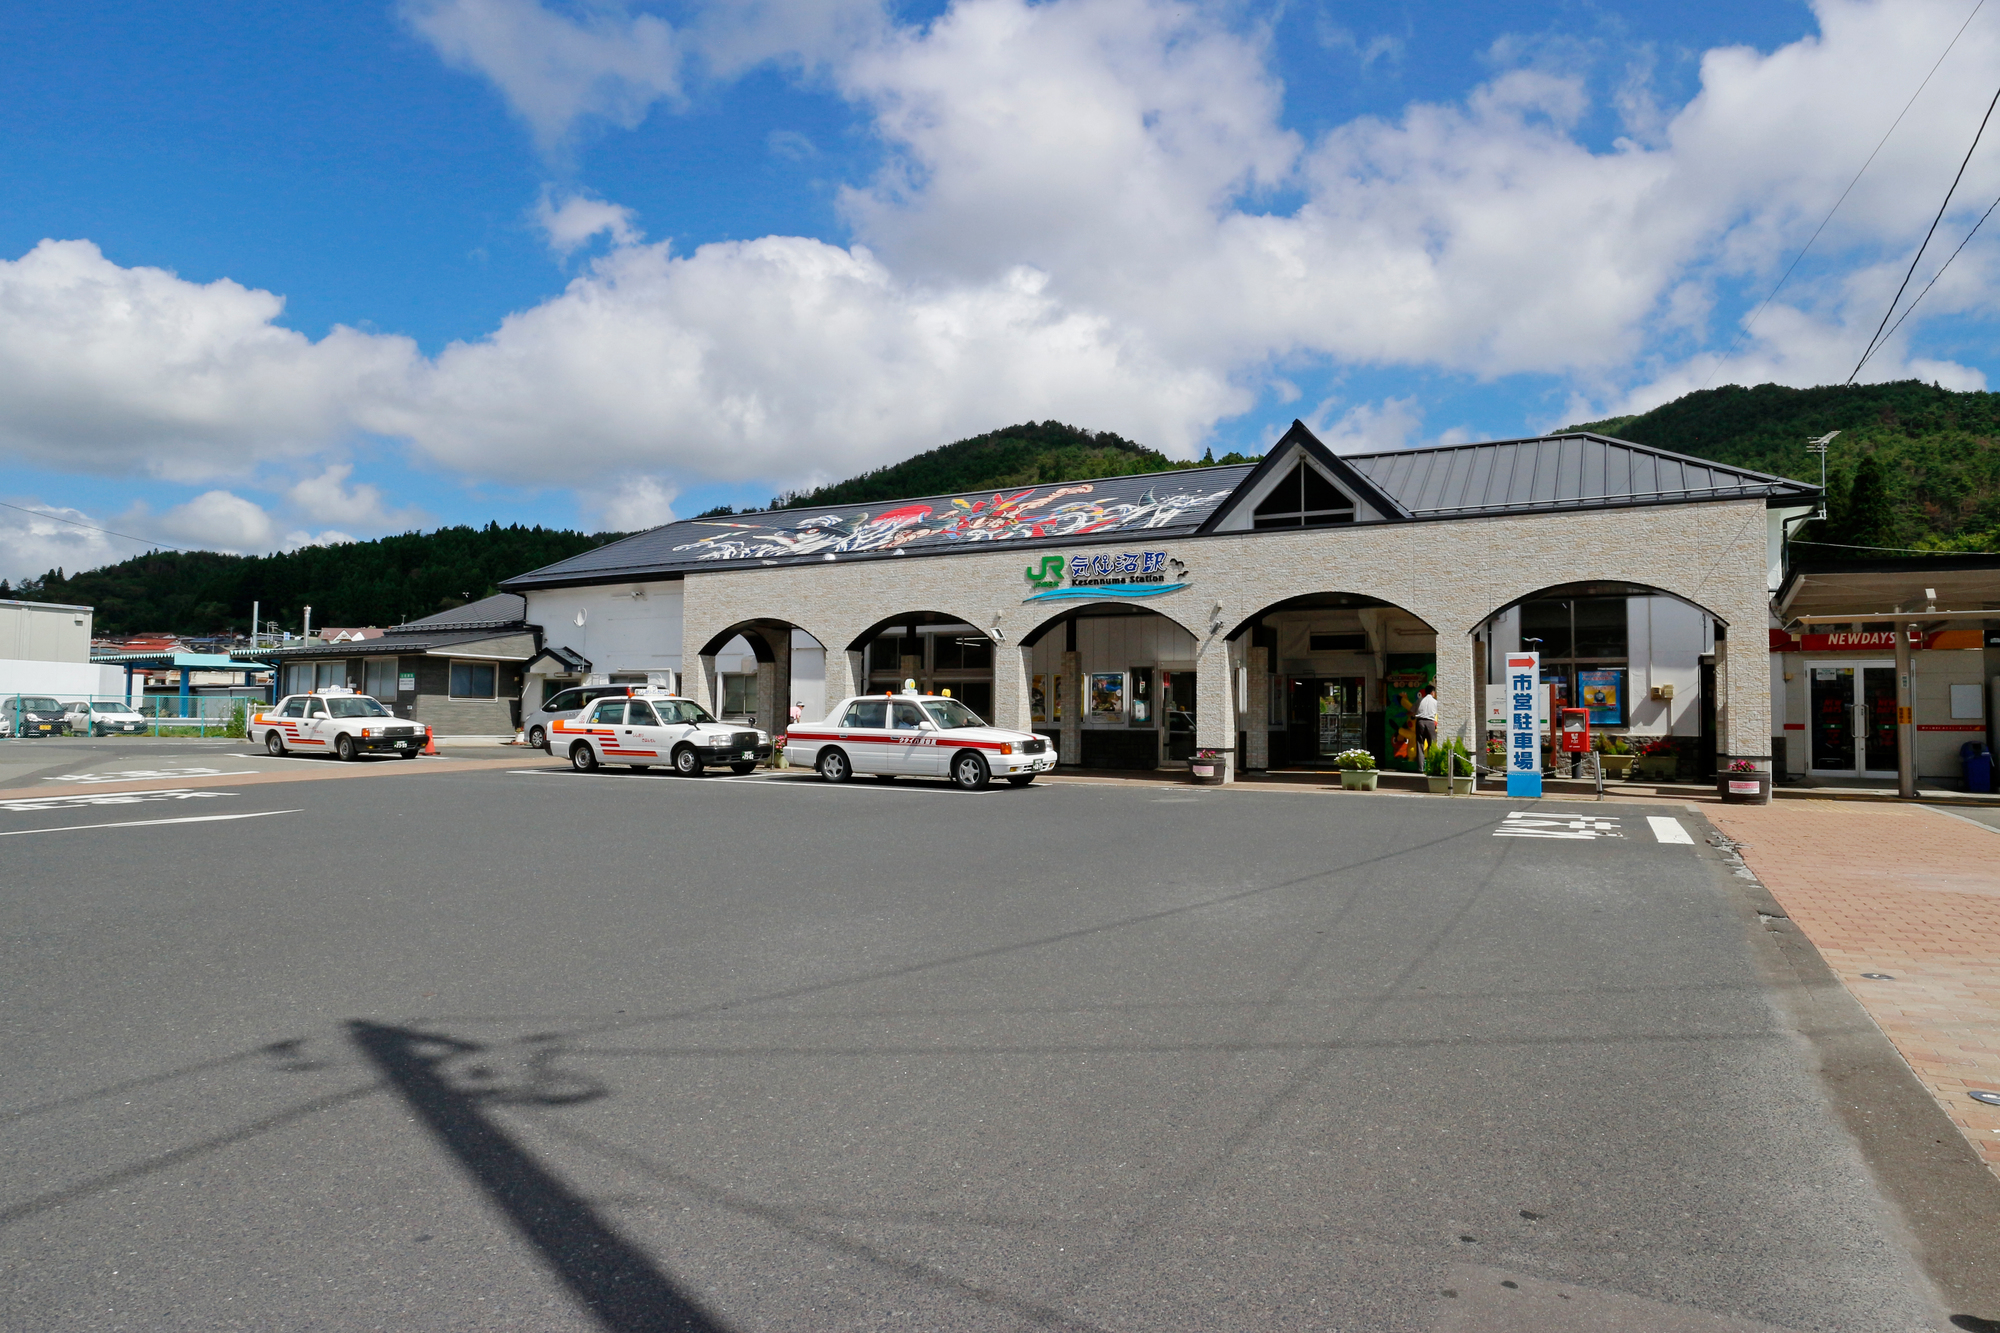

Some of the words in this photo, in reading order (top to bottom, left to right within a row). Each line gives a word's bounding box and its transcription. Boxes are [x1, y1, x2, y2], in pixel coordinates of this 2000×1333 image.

[1027, 555, 1065, 581] JR
[1071, 577, 1126, 587] Kesennuma
[1129, 574, 1165, 584] Station
[1828, 631, 1896, 645] NEWDAYS
[1512, 673, 1534, 770] 市営駐車場
